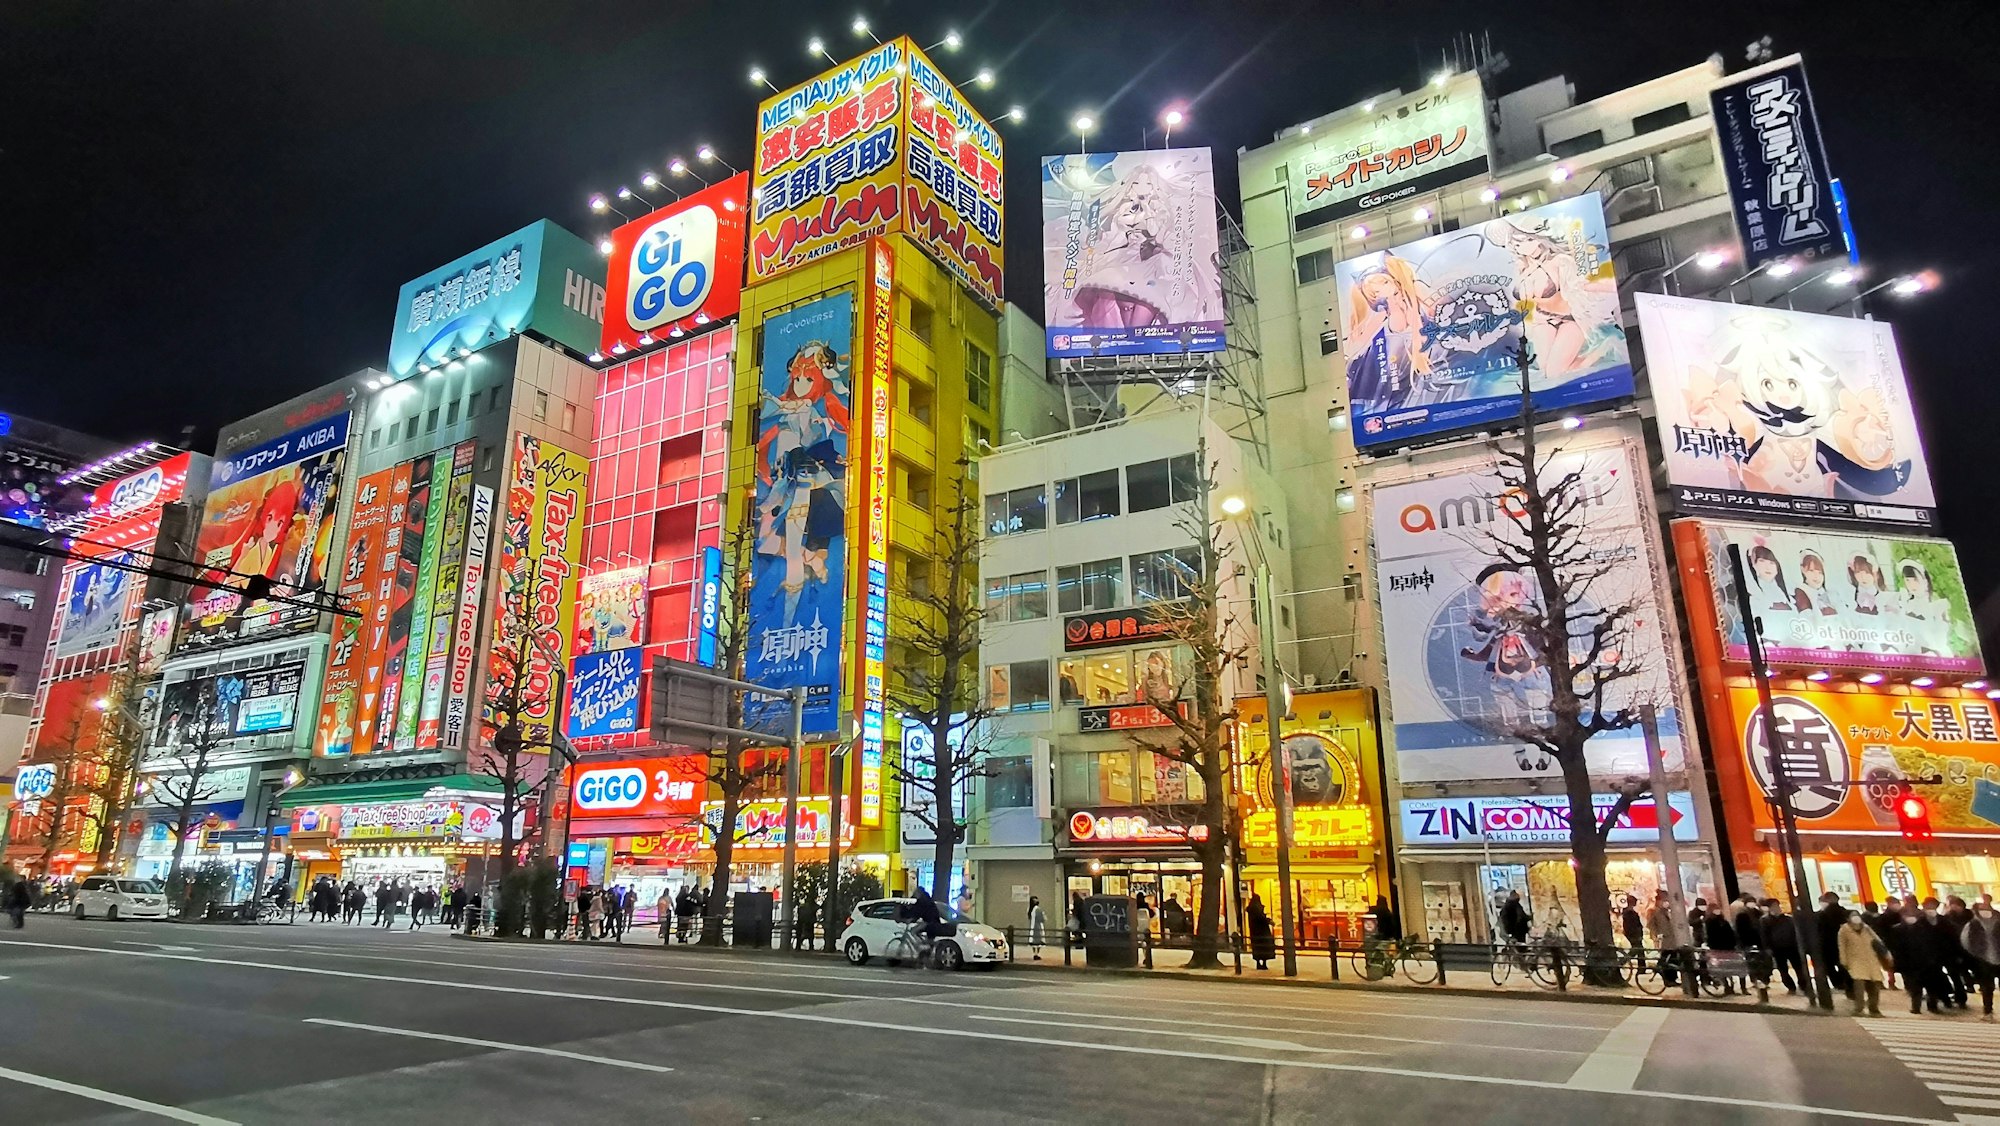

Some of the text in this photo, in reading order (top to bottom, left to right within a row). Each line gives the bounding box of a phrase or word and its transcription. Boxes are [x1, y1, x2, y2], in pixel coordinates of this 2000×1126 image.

[762, 43, 902, 132] MEDIAリサイクル
[910, 53, 1001, 159] MEDIAリサイクル
[760, 79, 898, 173] 激安販売
[910, 87, 1001, 200] 激安販売
[755, 126, 896, 222] 高額買取
[1307, 125, 1468, 200] メイドカジノ
[1748, 77, 1829, 244] アメニティドリーム
[907, 134, 1001, 243] 高額買取
[754, 184, 900, 275] Mulan
[907, 185, 1003, 300] Mulan
[1743, 199, 1768, 252] 秋葉原店
[766, 252, 806, 275] ムーラン
[807, 241, 838, 260] AKIBA
[917, 233, 949, 262] ムーラン
[948, 259, 970, 283] AKIBA
[406, 249, 524, 334] 廣瀬無線
[633, 261, 707, 321] GO
[236, 425, 336, 475] ソフマップ AKIBA
[1672, 422, 1750, 482] 原神
[355, 505, 385, 519] カードゲーム
[359, 482, 378, 506] 4F
[473, 489, 489, 549] AKKY
[1694, 492, 1721, 503] PS5
[1727, 495, 1755, 506] PS4
[1757, 498, 1791, 510] Windows
[346, 557, 365, 581] 3F
[535, 489, 577, 629] Tax-free
[1389, 564, 1435, 596] 原神
[460, 562, 482, 642] Tax-free
[702, 581, 718, 630] GiGO
[332, 641, 352, 667] 2F
[757, 606, 830, 678] 原神
[1884, 629, 1914, 644] cafe
[452, 645, 471, 695] Shop
[570, 657, 636, 718] オアシスに
[573, 650, 626, 695] ゲームの
[1111, 711, 1128, 726] 2F
[1849, 725, 1892, 740] チケット
[1893, 701, 1999, 744] 大黒屋
[1757, 711, 1846, 806] 質
[579, 770, 695, 803] GiGO 3号館
[1408, 801, 1439, 810] COMIC
[359, 806, 426, 825] Tax-free Shop
[1410, 801, 1479, 841] ZIN
[1486, 831, 1567, 841] Akihabara
